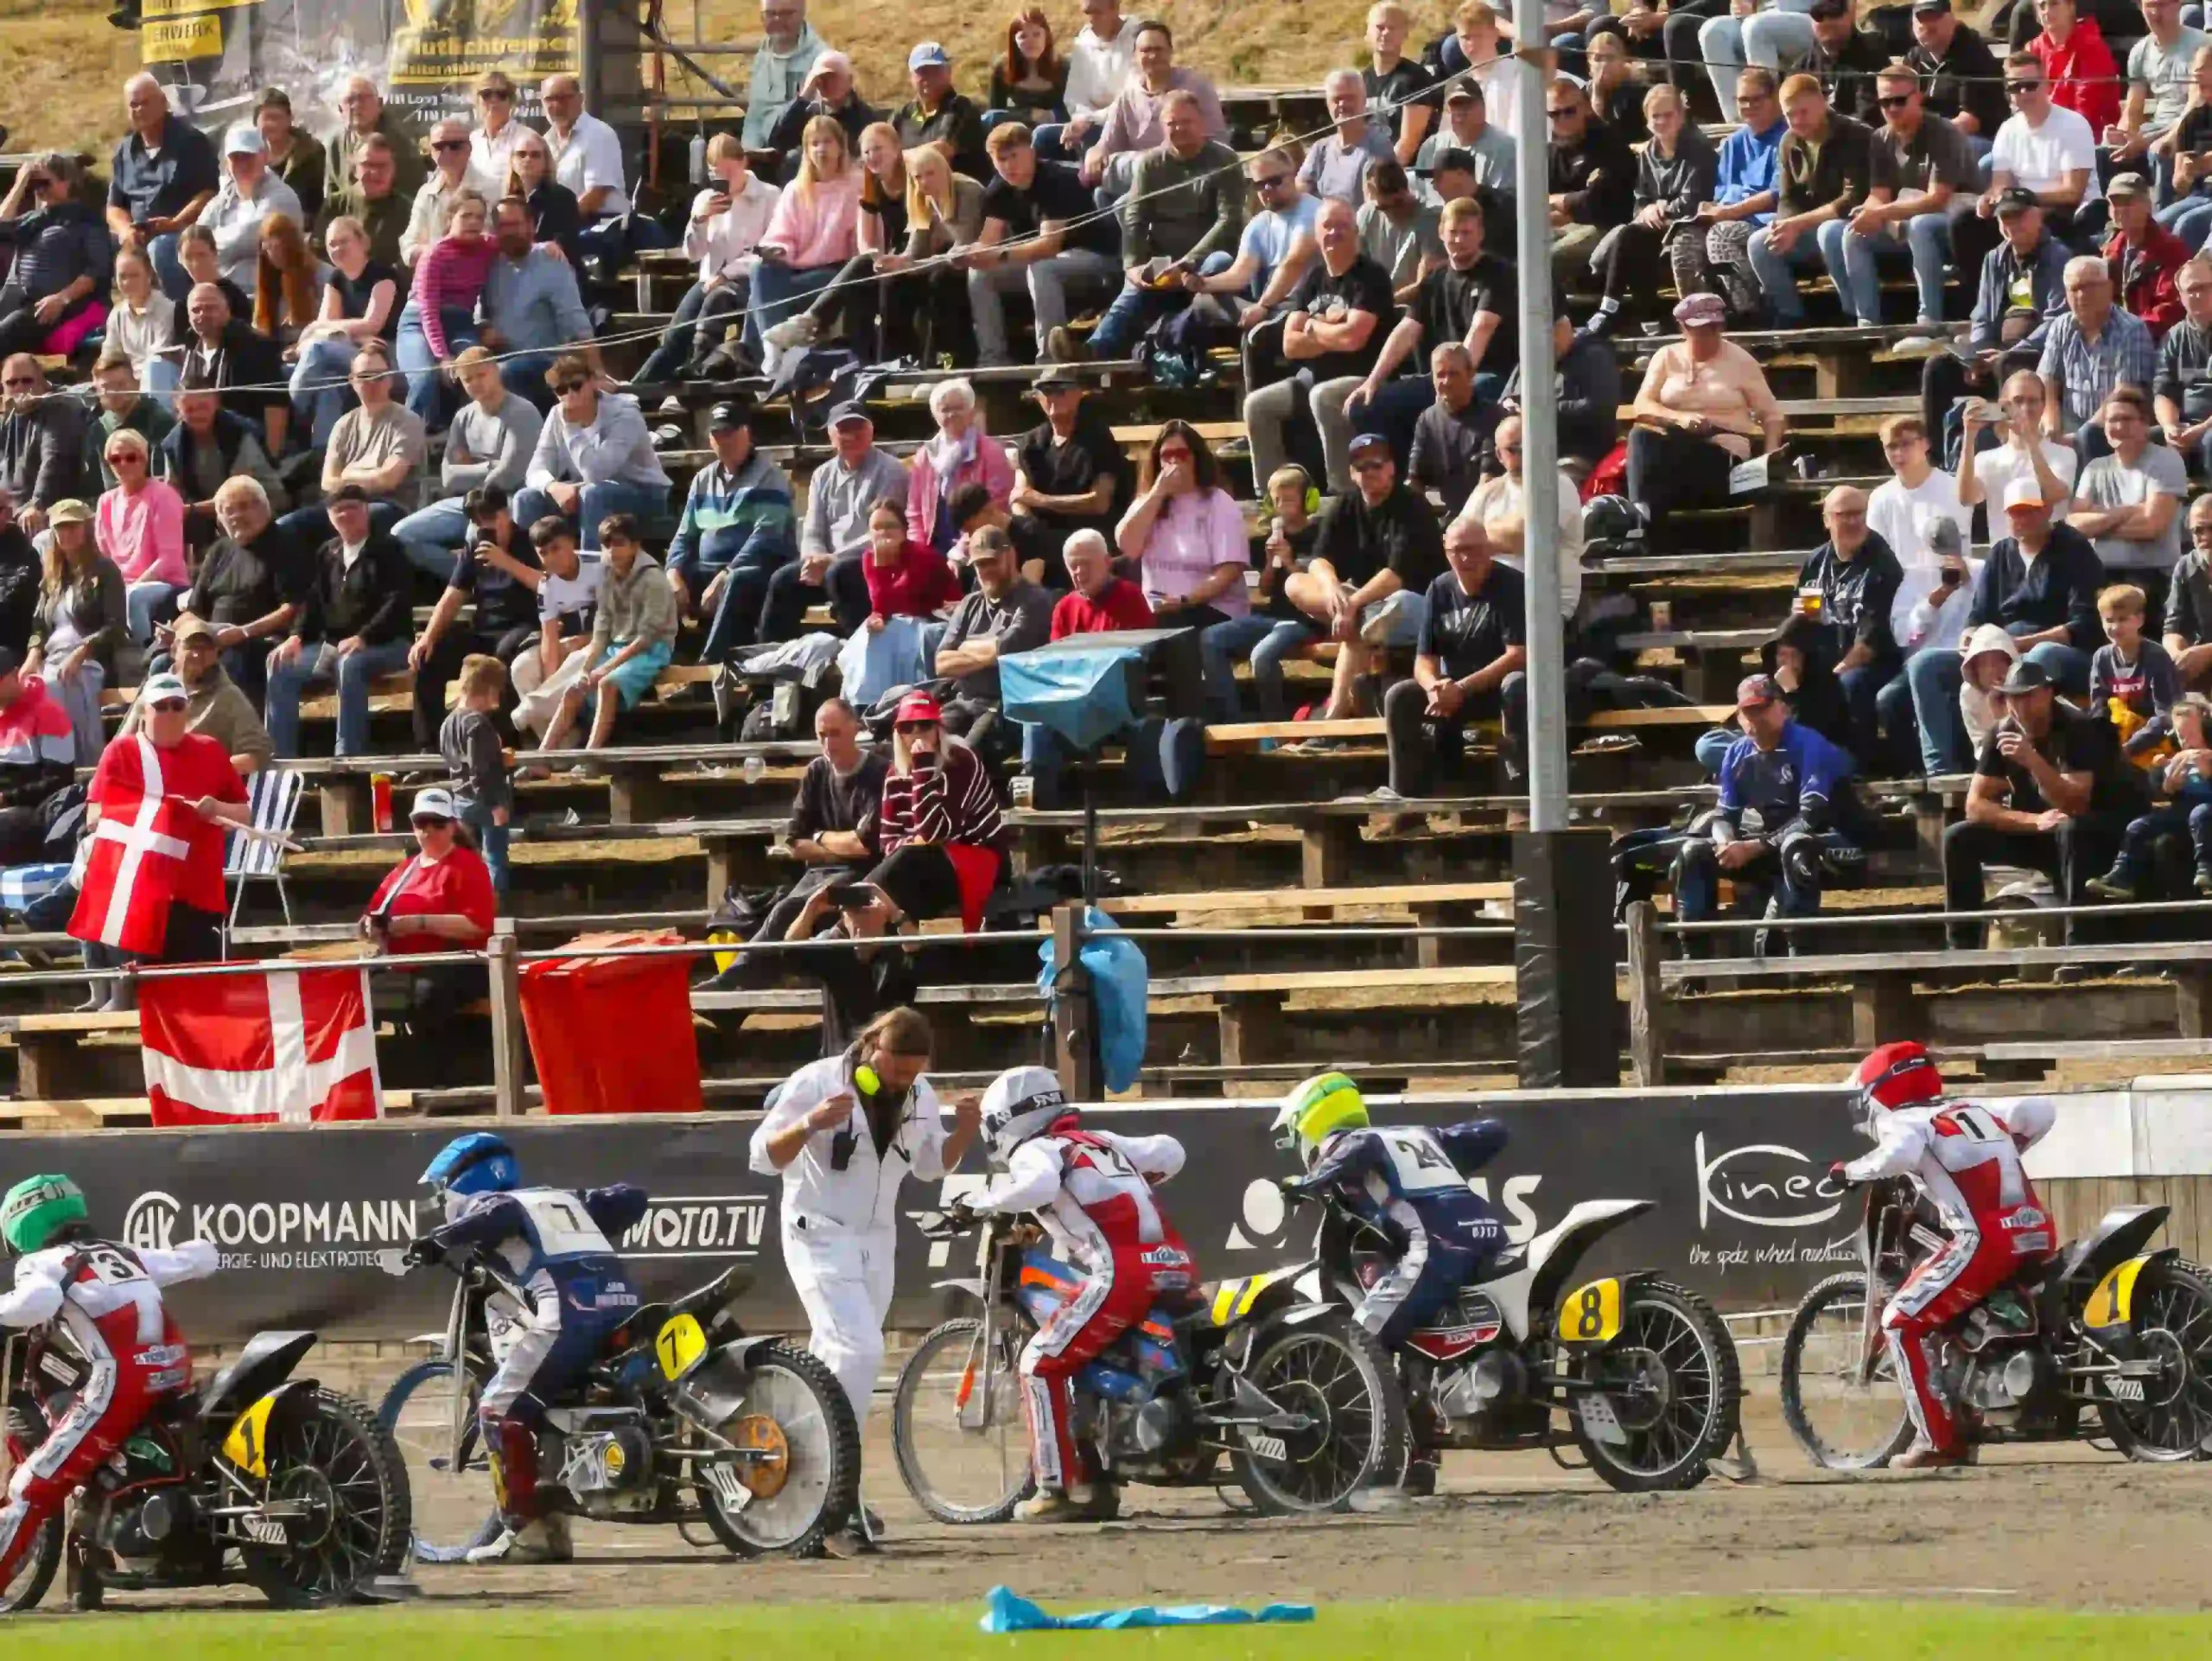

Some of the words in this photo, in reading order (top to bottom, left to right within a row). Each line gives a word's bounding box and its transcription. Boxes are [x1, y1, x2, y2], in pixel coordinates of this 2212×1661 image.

[1956, 1111, 1986, 1139] 1
[1395, 1139, 1453, 1169] 24
[193, 1200, 416, 1245] KOOPMANN
[98, 1252, 134, 1278] 3
[261, 1252, 291, 1269] UND
[1578, 1286, 1603, 1338] 8
[239, 1416, 260, 1469] 1
